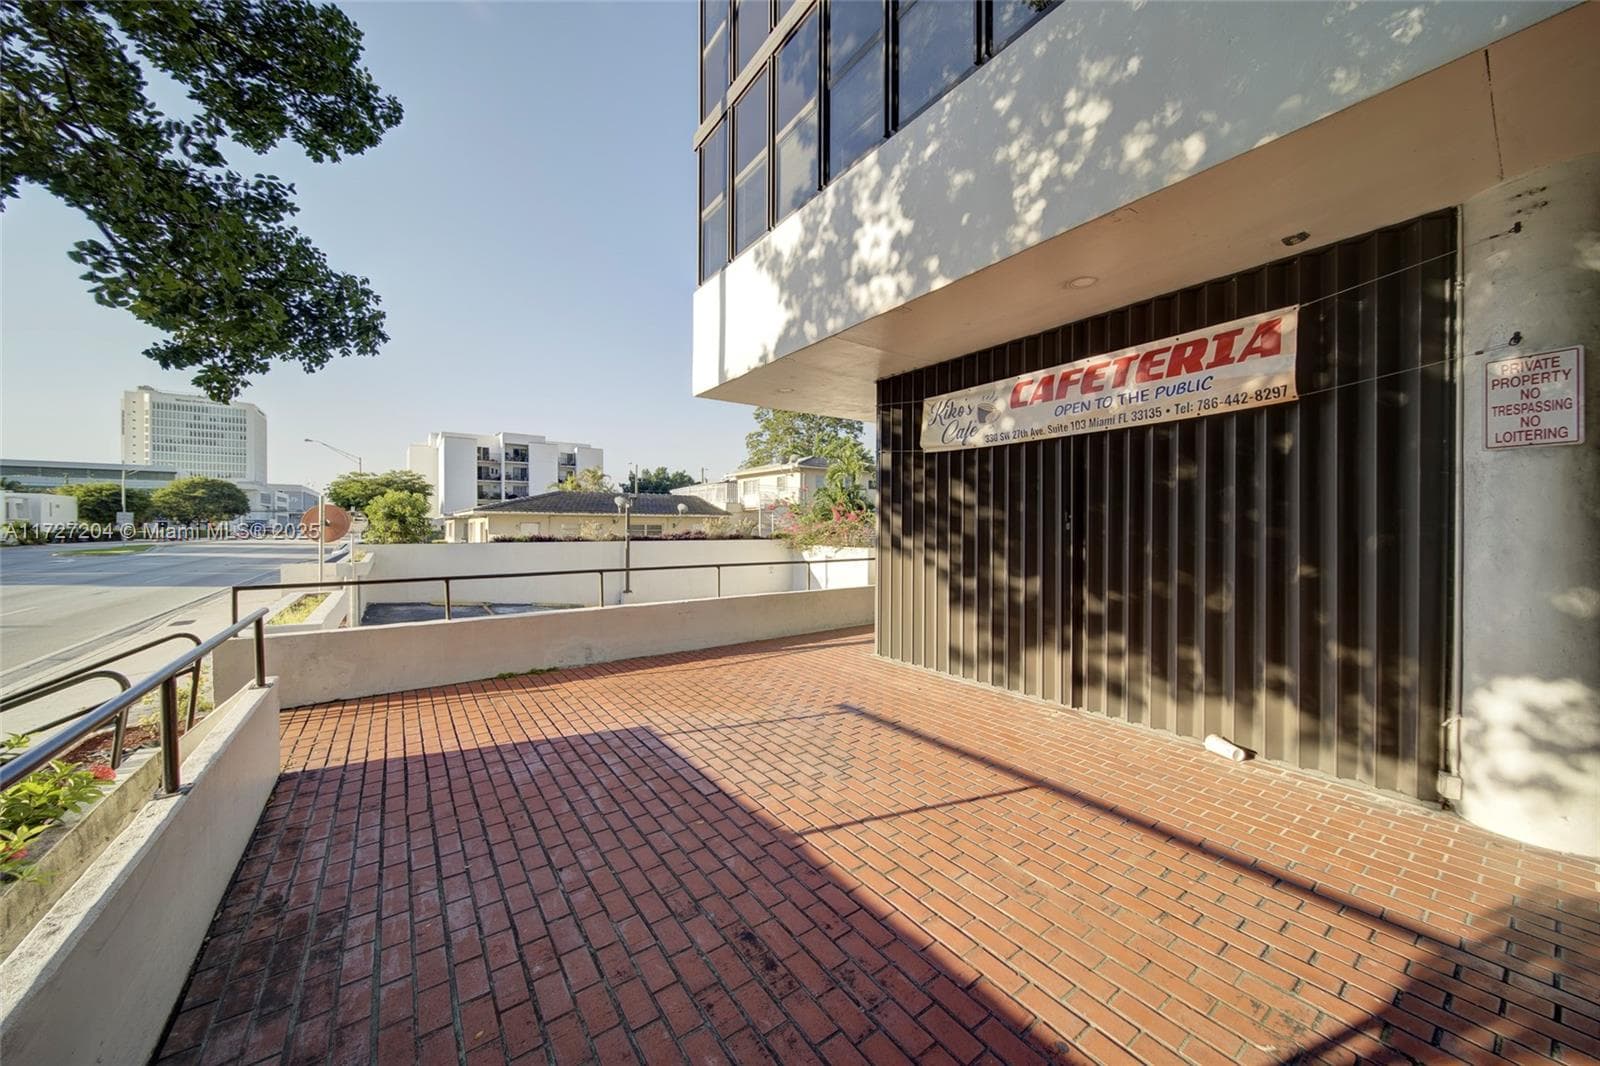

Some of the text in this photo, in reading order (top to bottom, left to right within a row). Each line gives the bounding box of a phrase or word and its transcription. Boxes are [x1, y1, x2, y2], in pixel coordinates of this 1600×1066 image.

[1009, 316, 1284, 410] CAFETERIA
[1501, 356, 1560, 375] PRIVATE
[1491, 368, 1571, 390] PROPERTY
[1055, 376, 1214, 417] OPEN TO THE PUBLIC
[1520, 387, 1541, 400] NO
[928, 398, 976, 426] Kiko's
[1012, 429, 1028, 440] 27th
[1030, 426, 1045, 438] Ave.
[1047, 423, 1068, 434] Suite
[1070, 419, 1086, 431] 103
[1089, 417, 1116, 428] Miami
[1118, 414, 1128, 425] FL
[1131, 407, 1162, 422] 33135
[1174, 402, 1193, 415] Tel:
[1197, 385, 1288, 411] 786-442-8297
[1491, 398, 1573, 417] TRESPASSING
[1520, 415, 1541, 427] NO
[1495, 426, 1569, 443] LOITERING
